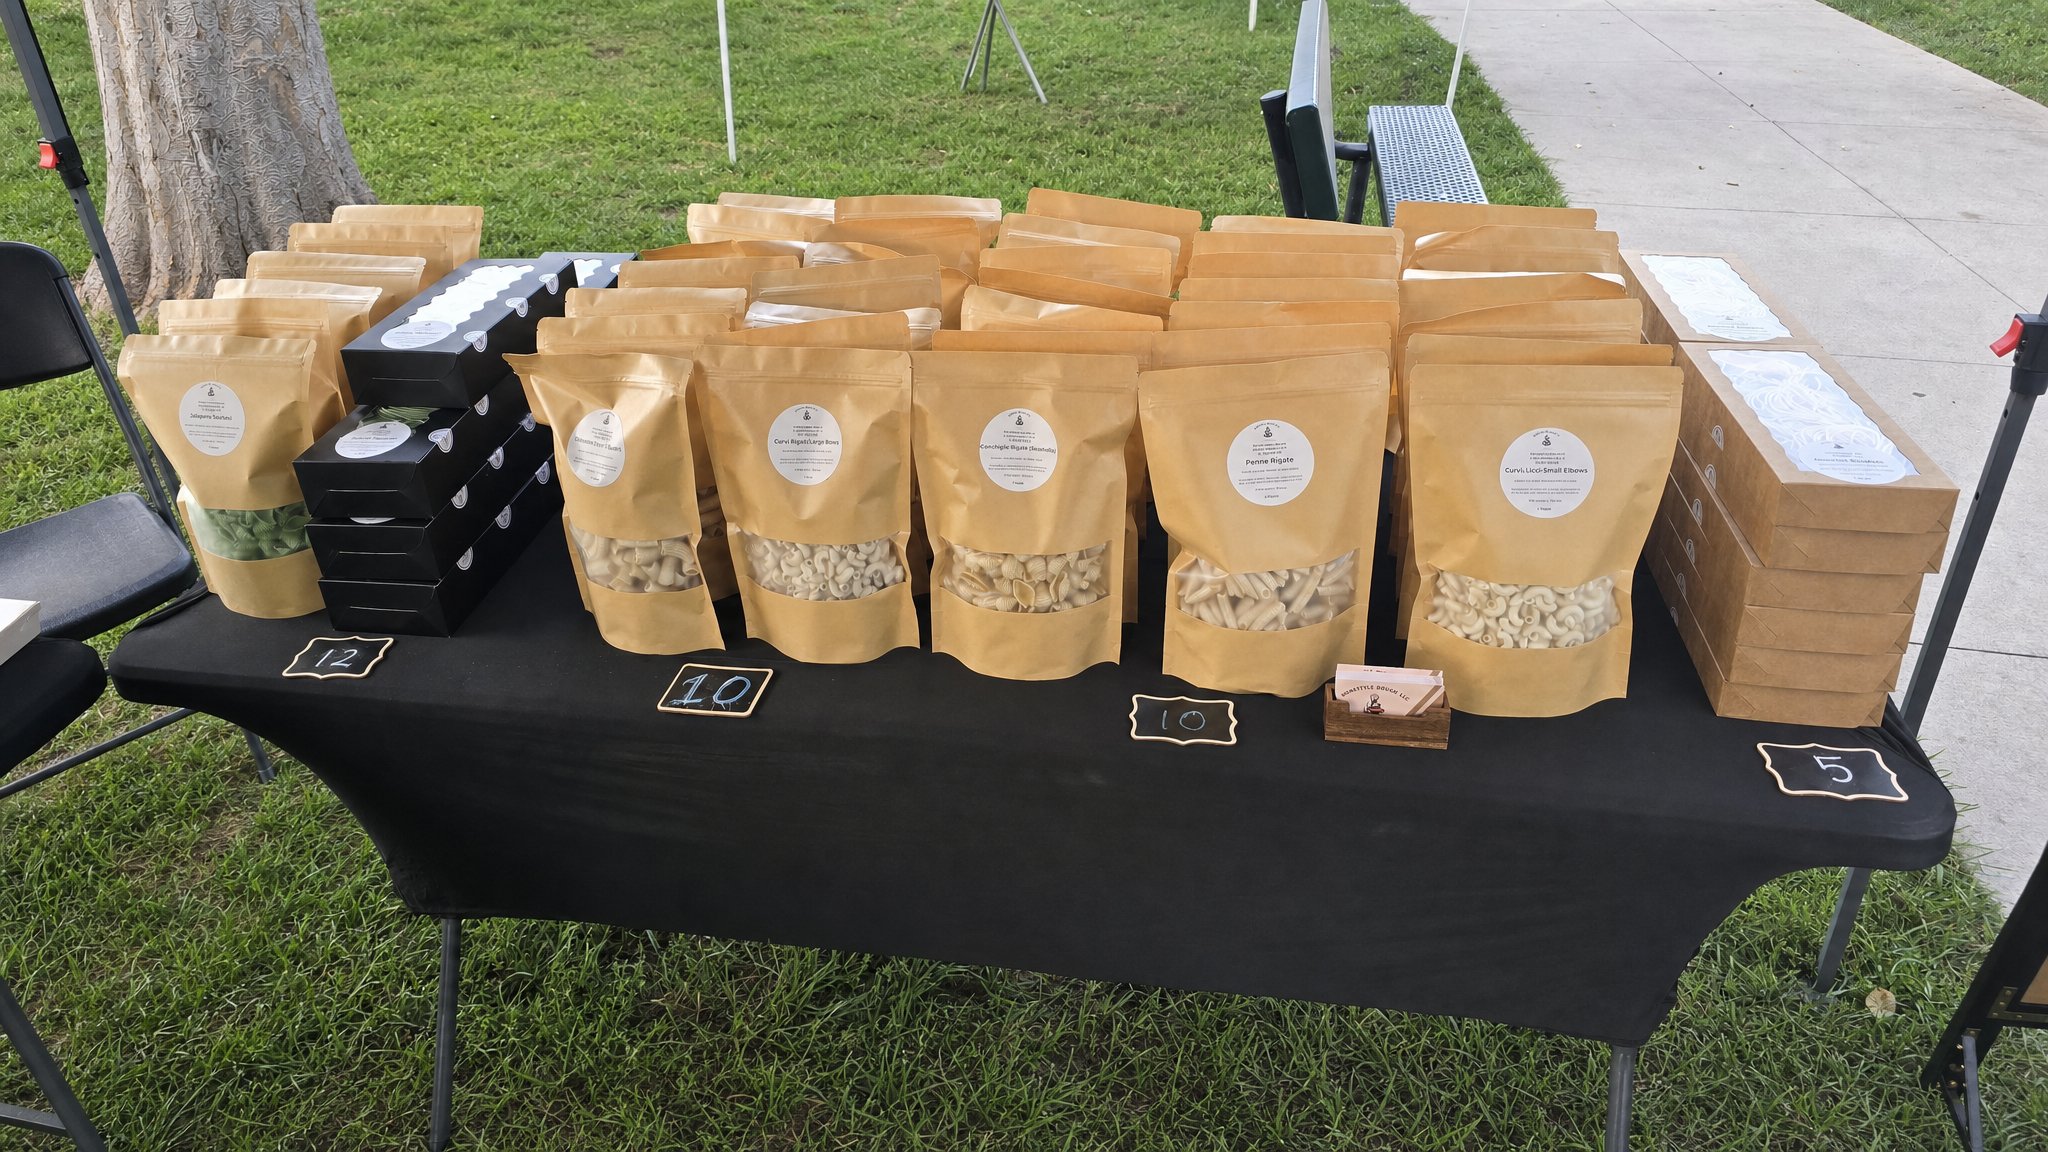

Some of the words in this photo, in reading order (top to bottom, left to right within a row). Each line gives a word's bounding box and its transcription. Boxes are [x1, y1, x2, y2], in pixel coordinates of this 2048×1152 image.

[1270, 457, 1294, 465] Rigate
[314, 648, 358, 668] 12
[668, 673, 751, 705] 10
[1341, 684, 1374, 697] HOMESTYLE
[1376, 685, 1398, 695] DOUGH
[1399, 692, 1410, 702] LLC
[1161, 709, 1206, 731] 10
[1812, 755, 1853, 783] 5
